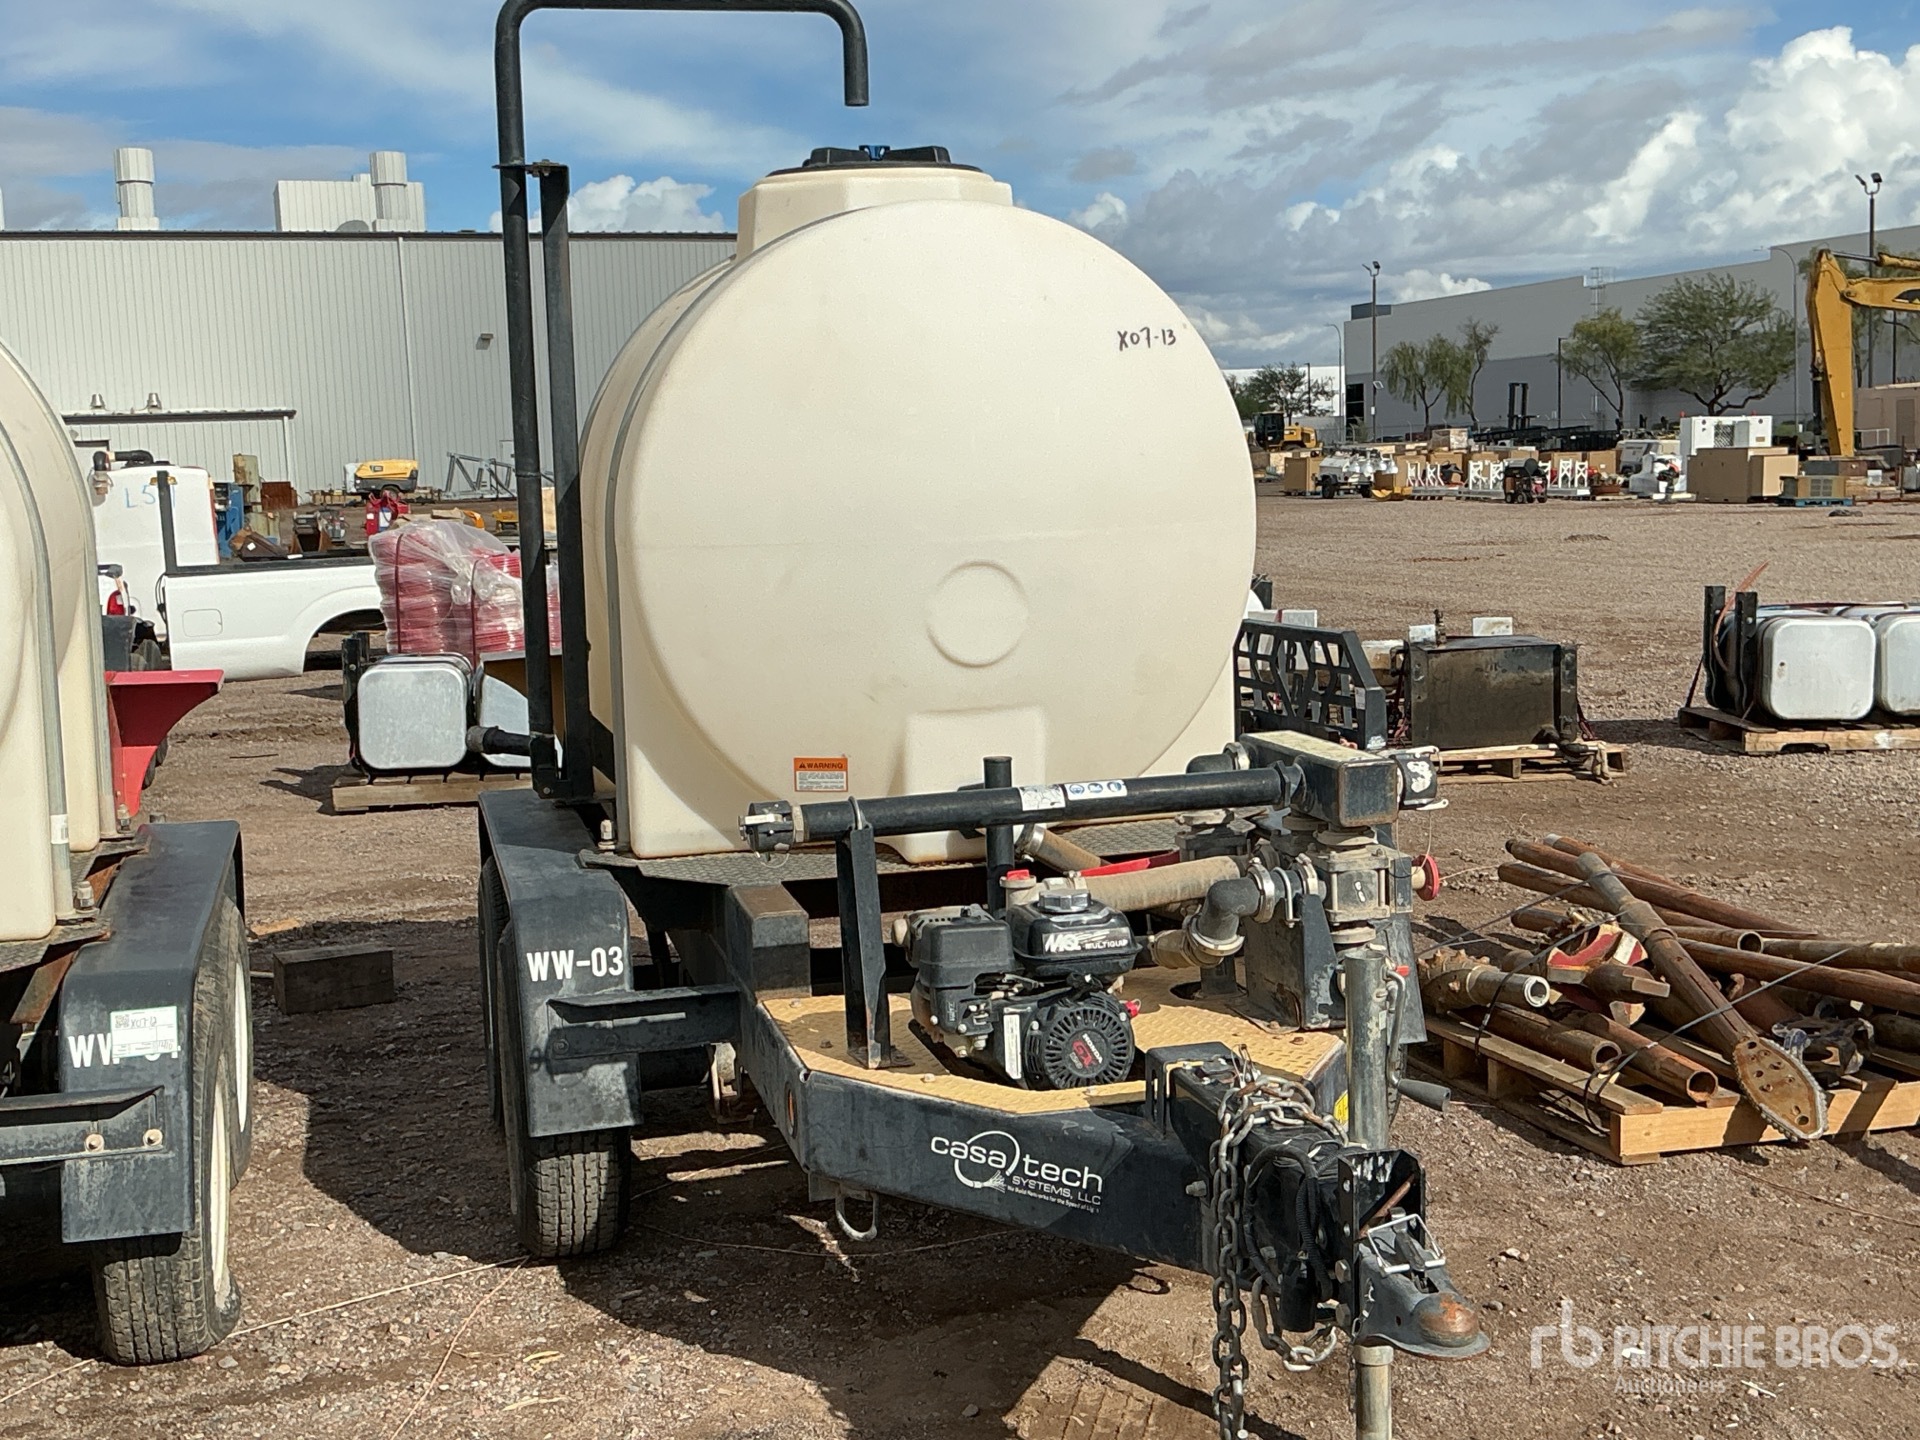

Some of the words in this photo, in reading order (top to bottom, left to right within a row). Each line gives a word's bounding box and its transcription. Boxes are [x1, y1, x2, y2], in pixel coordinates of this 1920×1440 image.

[526, 946, 624, 982] WW-03
[1082, 1033, 1103, 1064] HONDA
[1012, 1175, 1073, 1199] SYSTEMS,
[1078, 1191, 1101, 1205] LLC
[1023, 1154, 1103, 1193] tech
